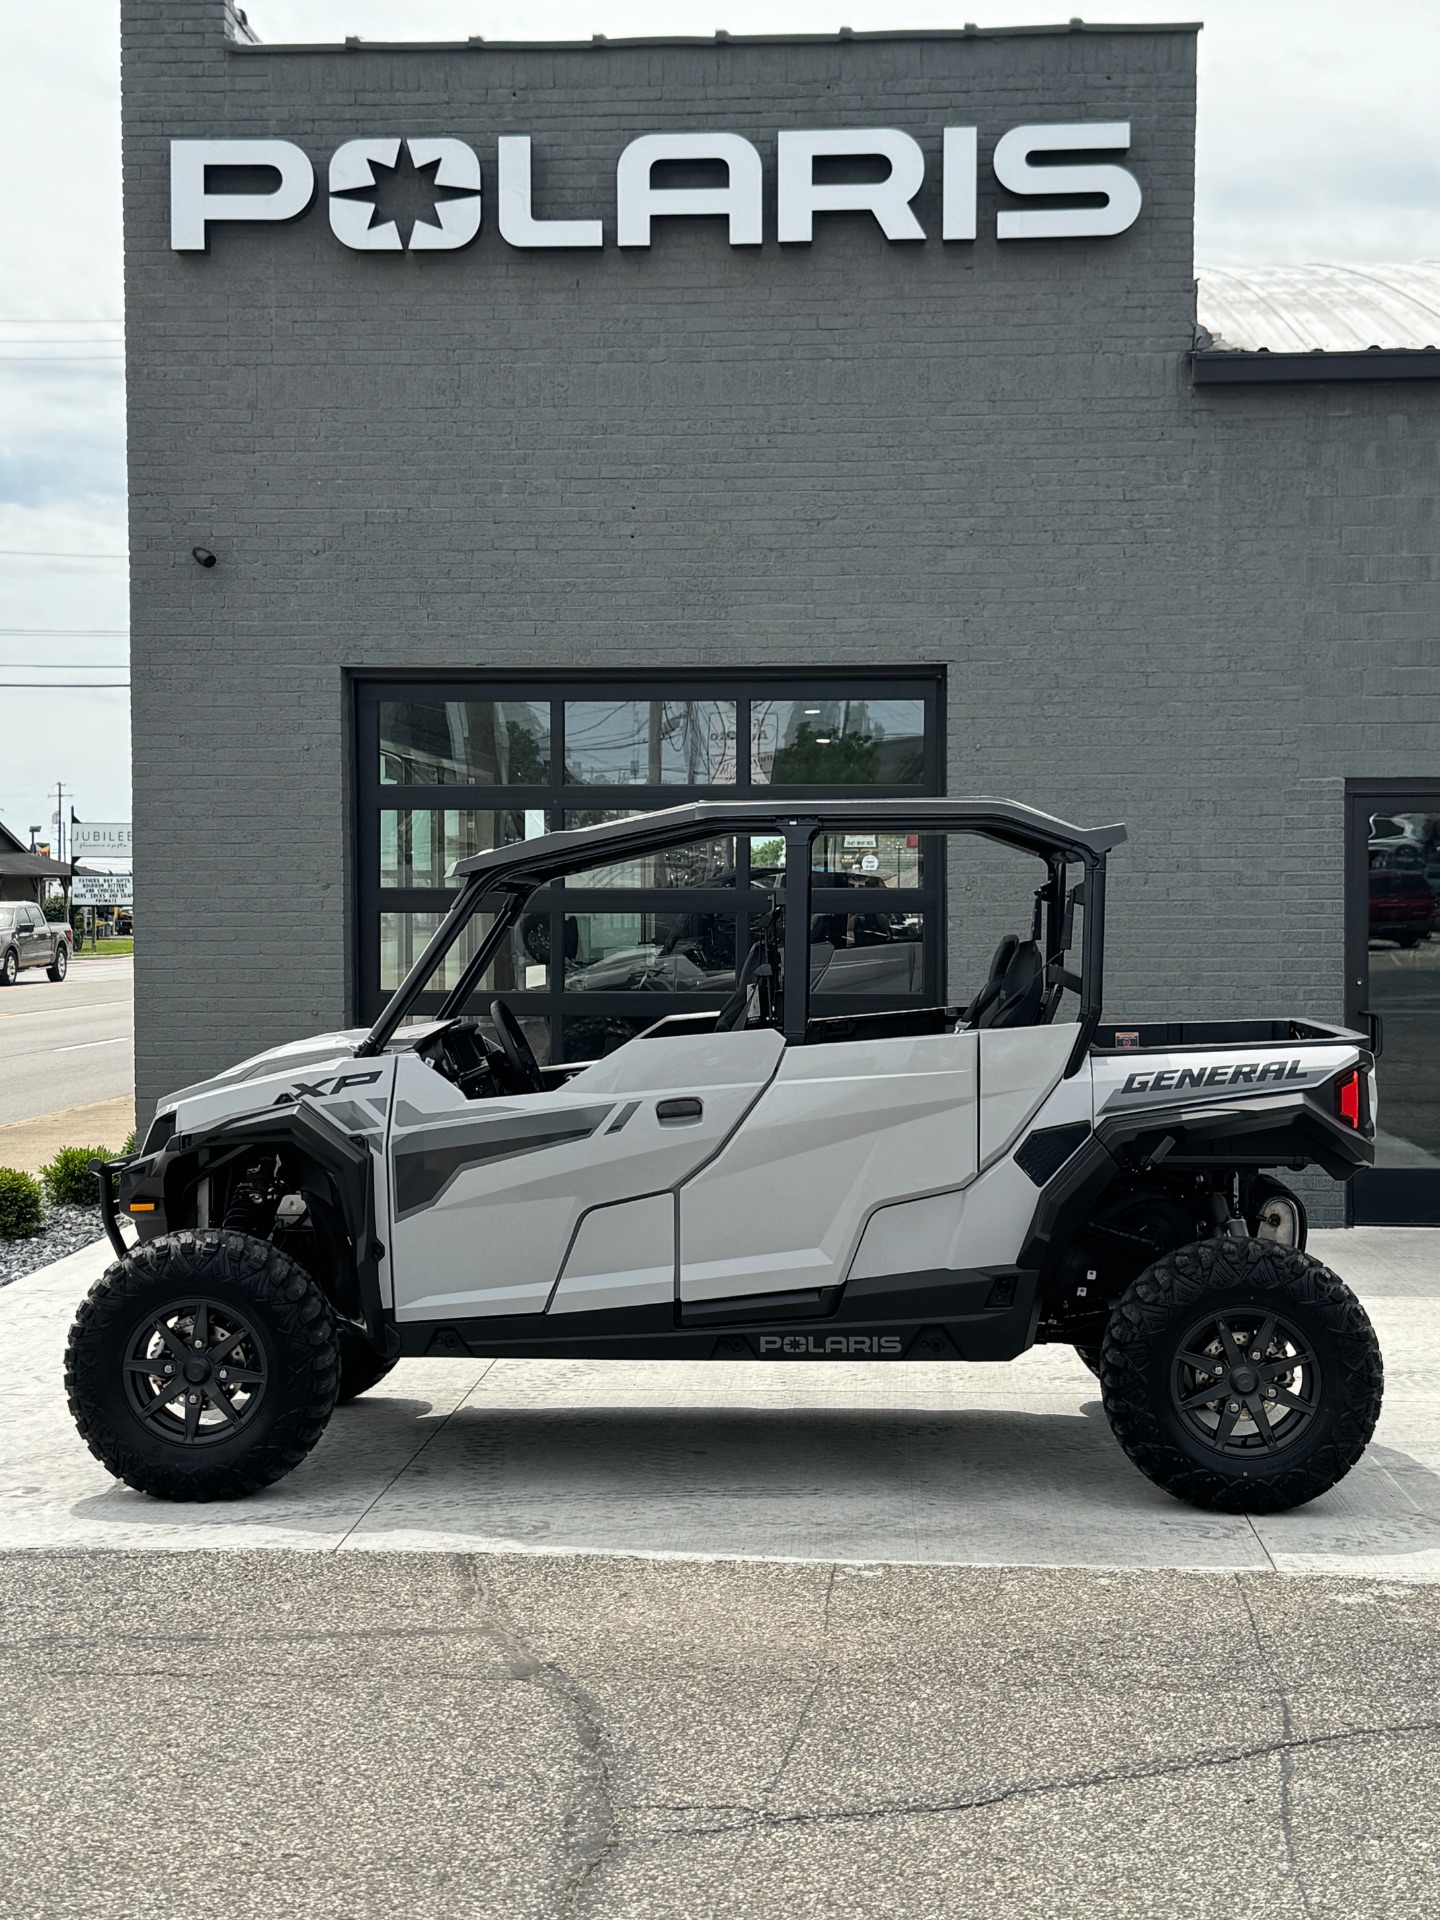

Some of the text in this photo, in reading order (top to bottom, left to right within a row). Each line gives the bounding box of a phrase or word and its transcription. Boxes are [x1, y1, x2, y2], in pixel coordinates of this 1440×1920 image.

[170, 121, 1144, 252] POLARIS
[74, 831, 132, 842] JUBILEE
[291, 1070, 383, 1100] XP
[1121, 1060, 1307, 1094] GENERAL
[760, 1336, 902, 1353] POLARIS
